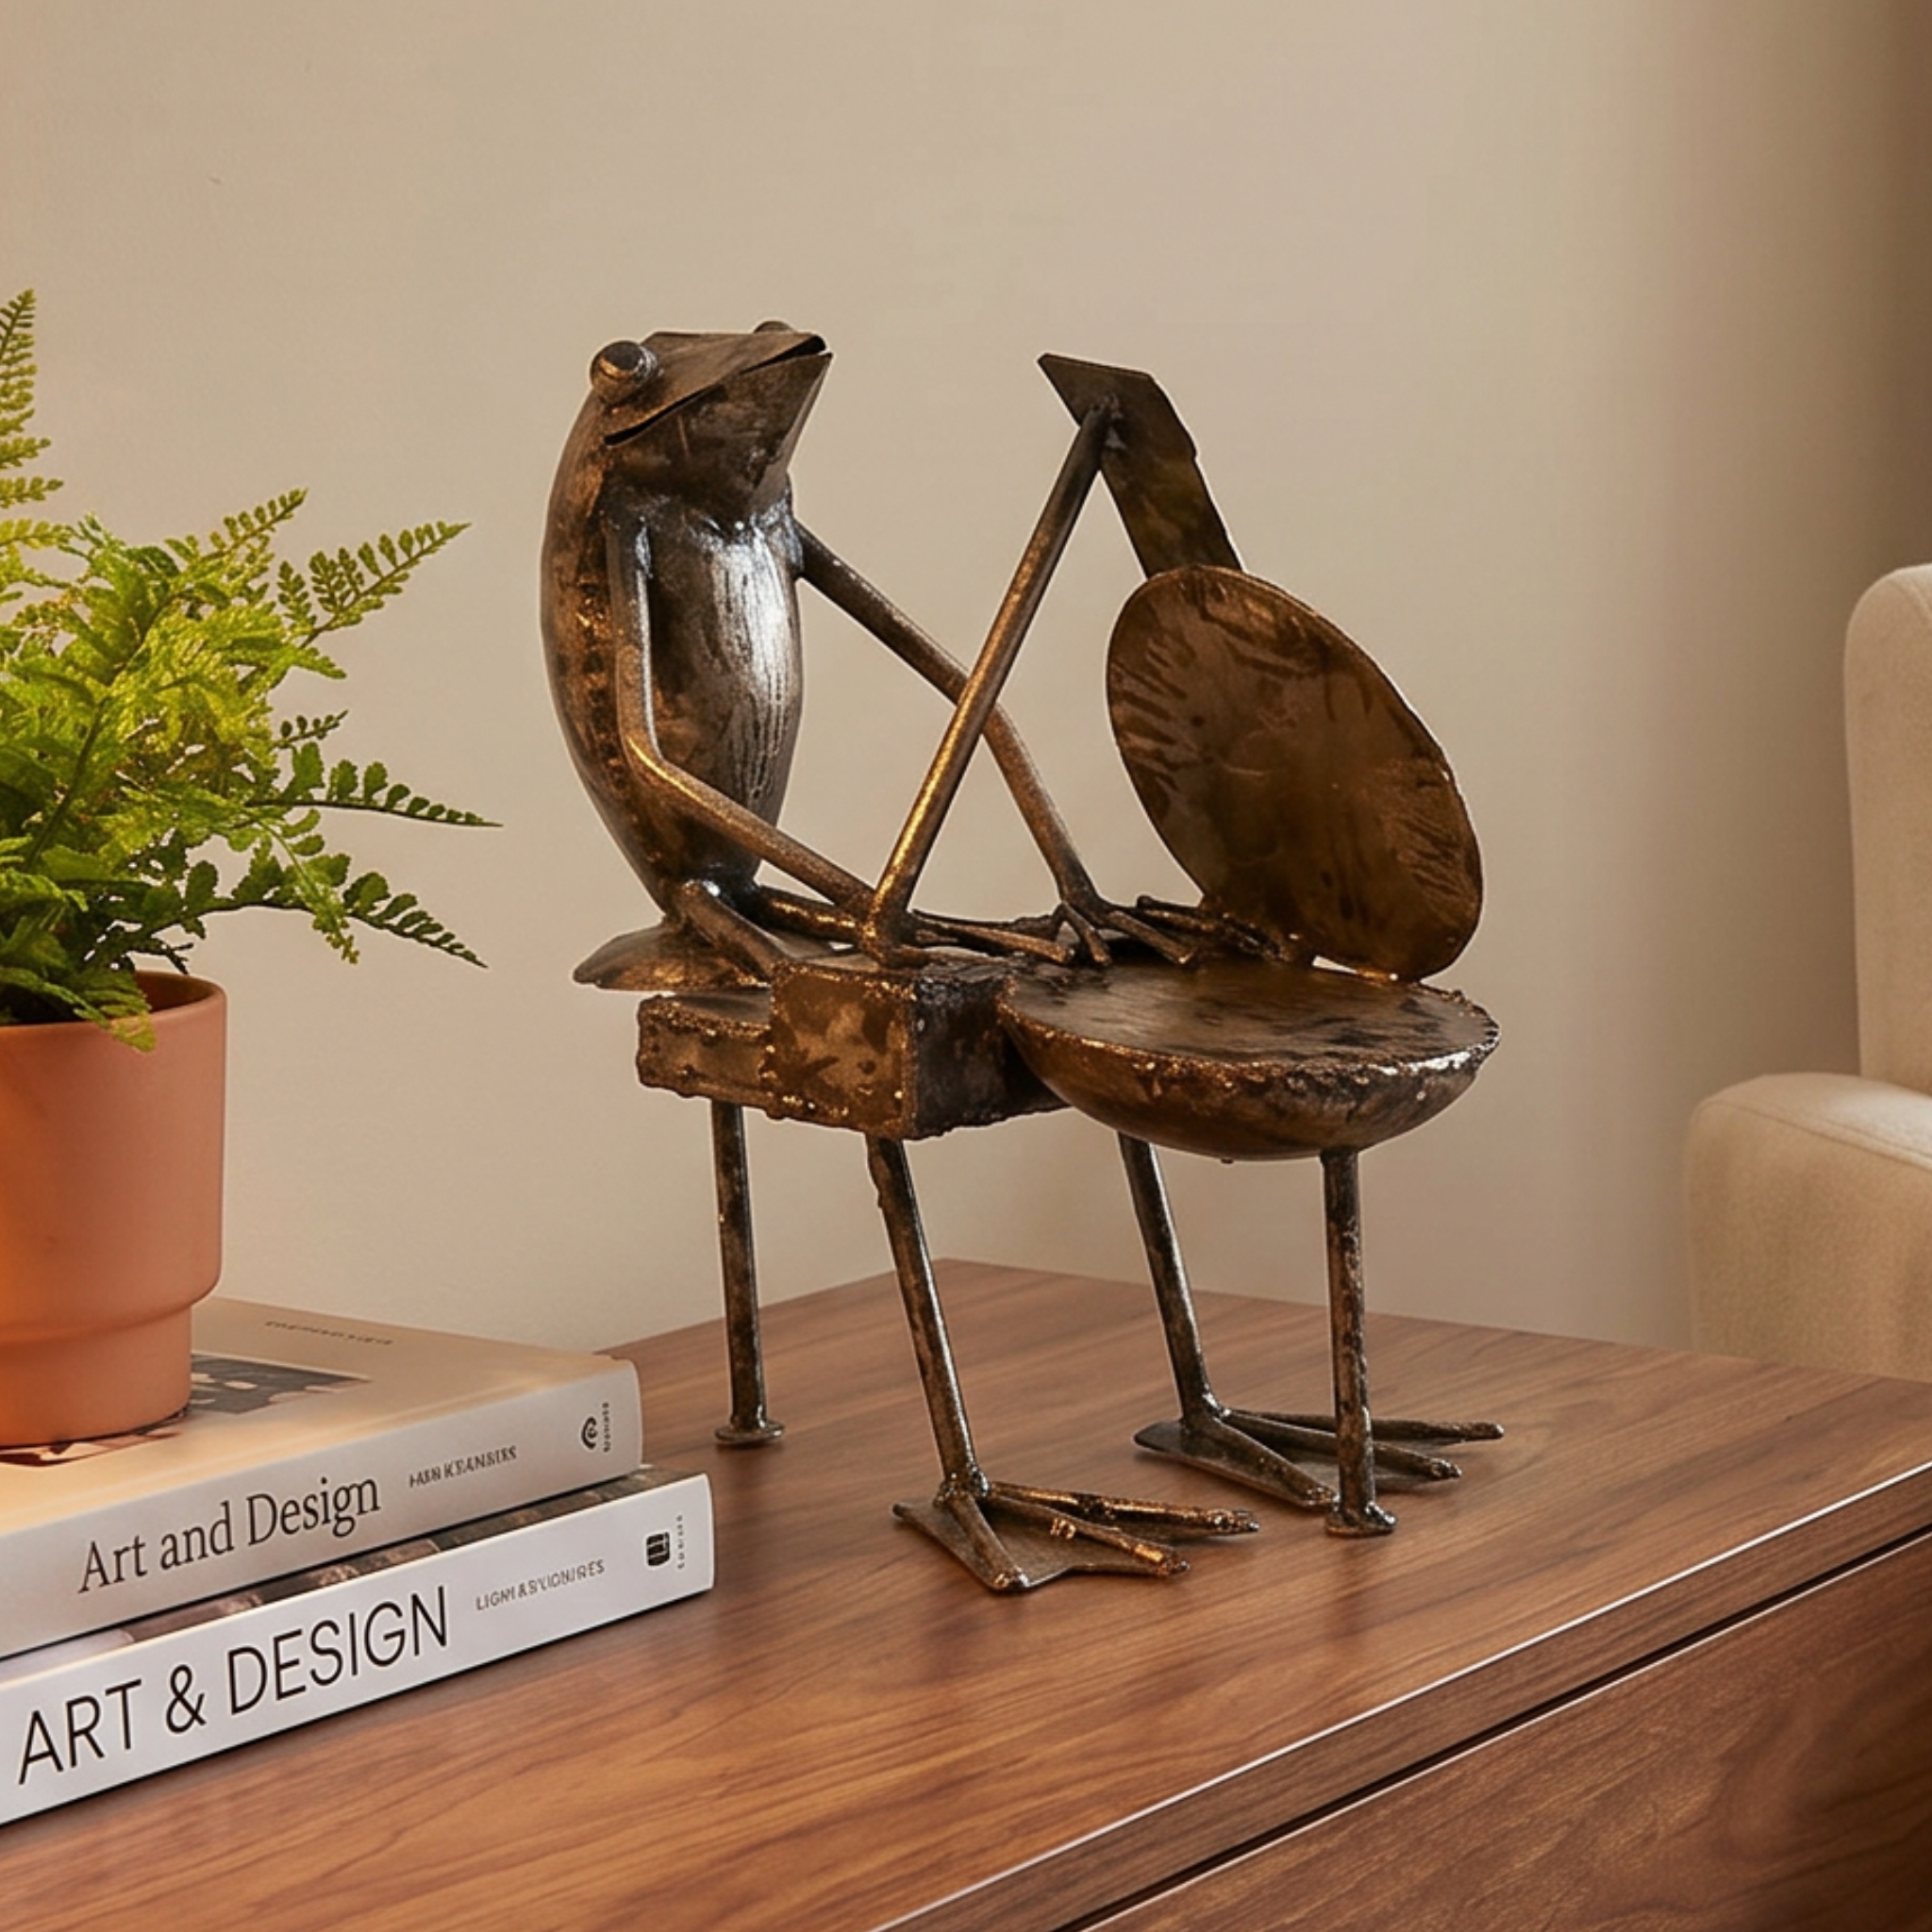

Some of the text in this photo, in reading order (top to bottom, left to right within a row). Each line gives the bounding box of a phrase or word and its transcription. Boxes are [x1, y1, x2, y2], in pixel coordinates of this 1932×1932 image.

[77, 1476, 381, 1593] Art and Design
[19, 1586, 447, 1785] ART & DESIGN
